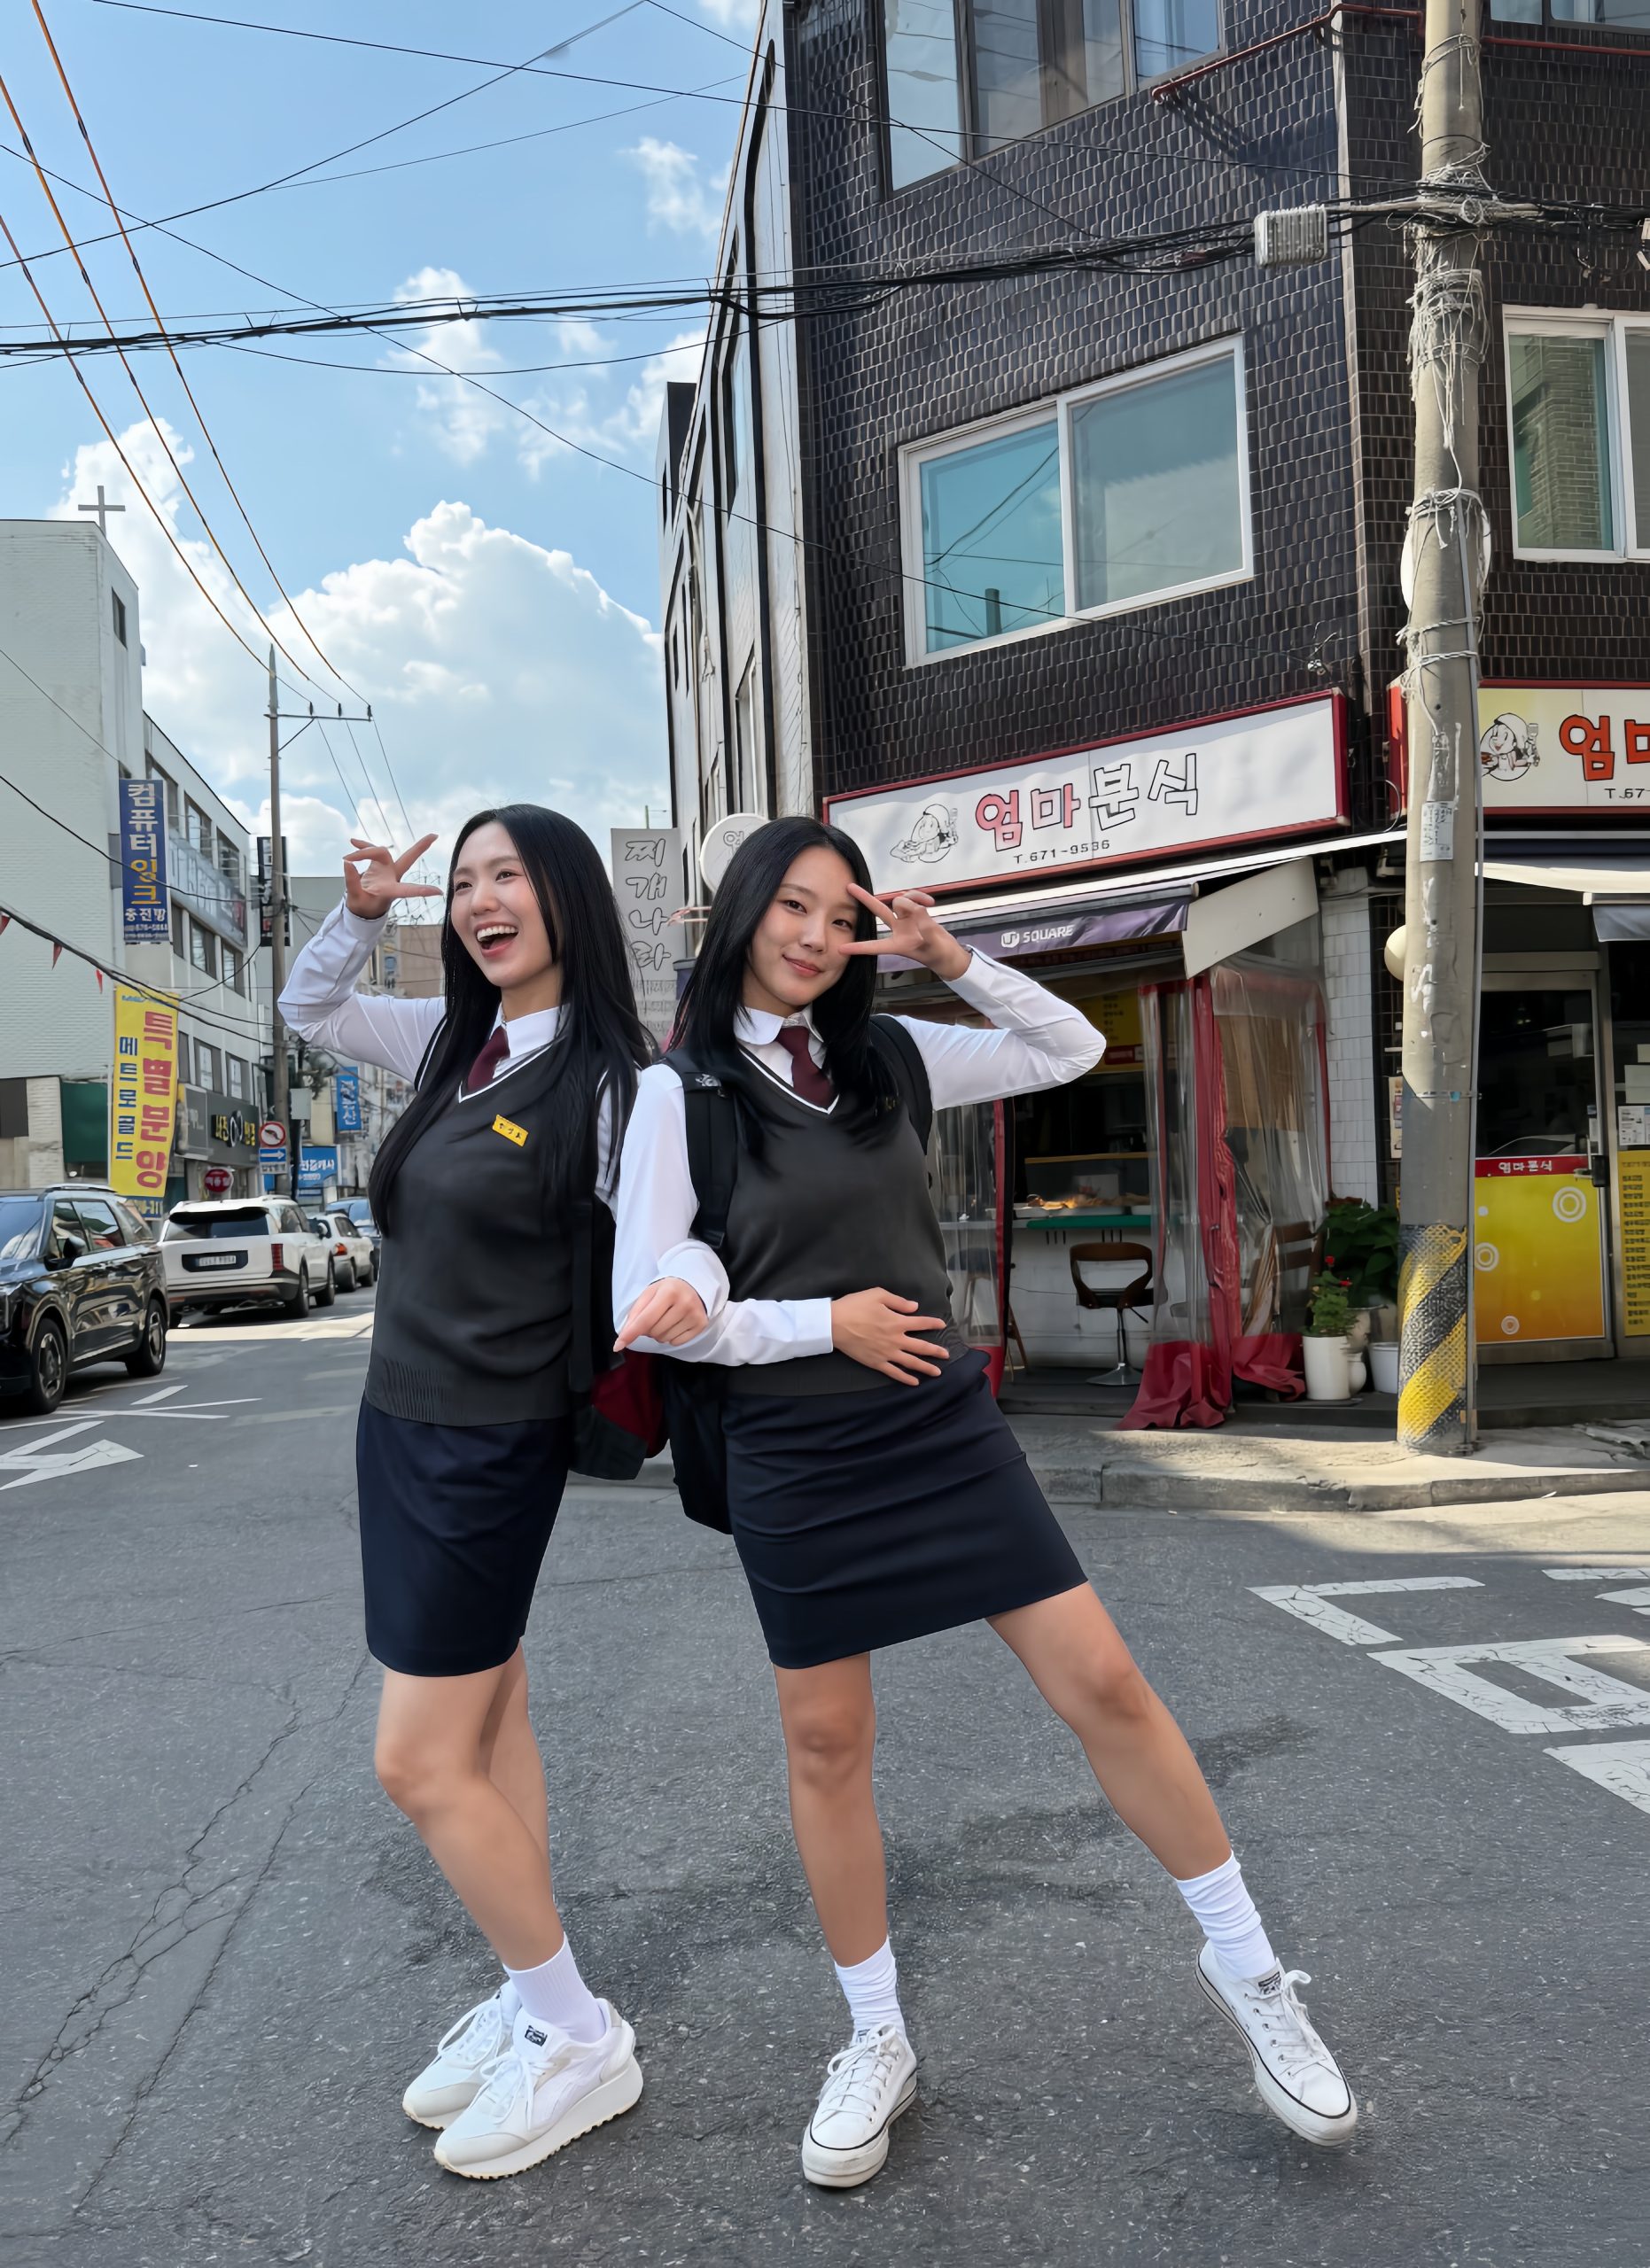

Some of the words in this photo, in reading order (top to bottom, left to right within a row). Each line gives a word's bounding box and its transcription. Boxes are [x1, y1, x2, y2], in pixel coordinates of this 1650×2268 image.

[975, 753, 1198, 852] 엄마분식
[1604, 788, 1650, 799] T.67
[1023, 924, 1076, 944] SQUARE
